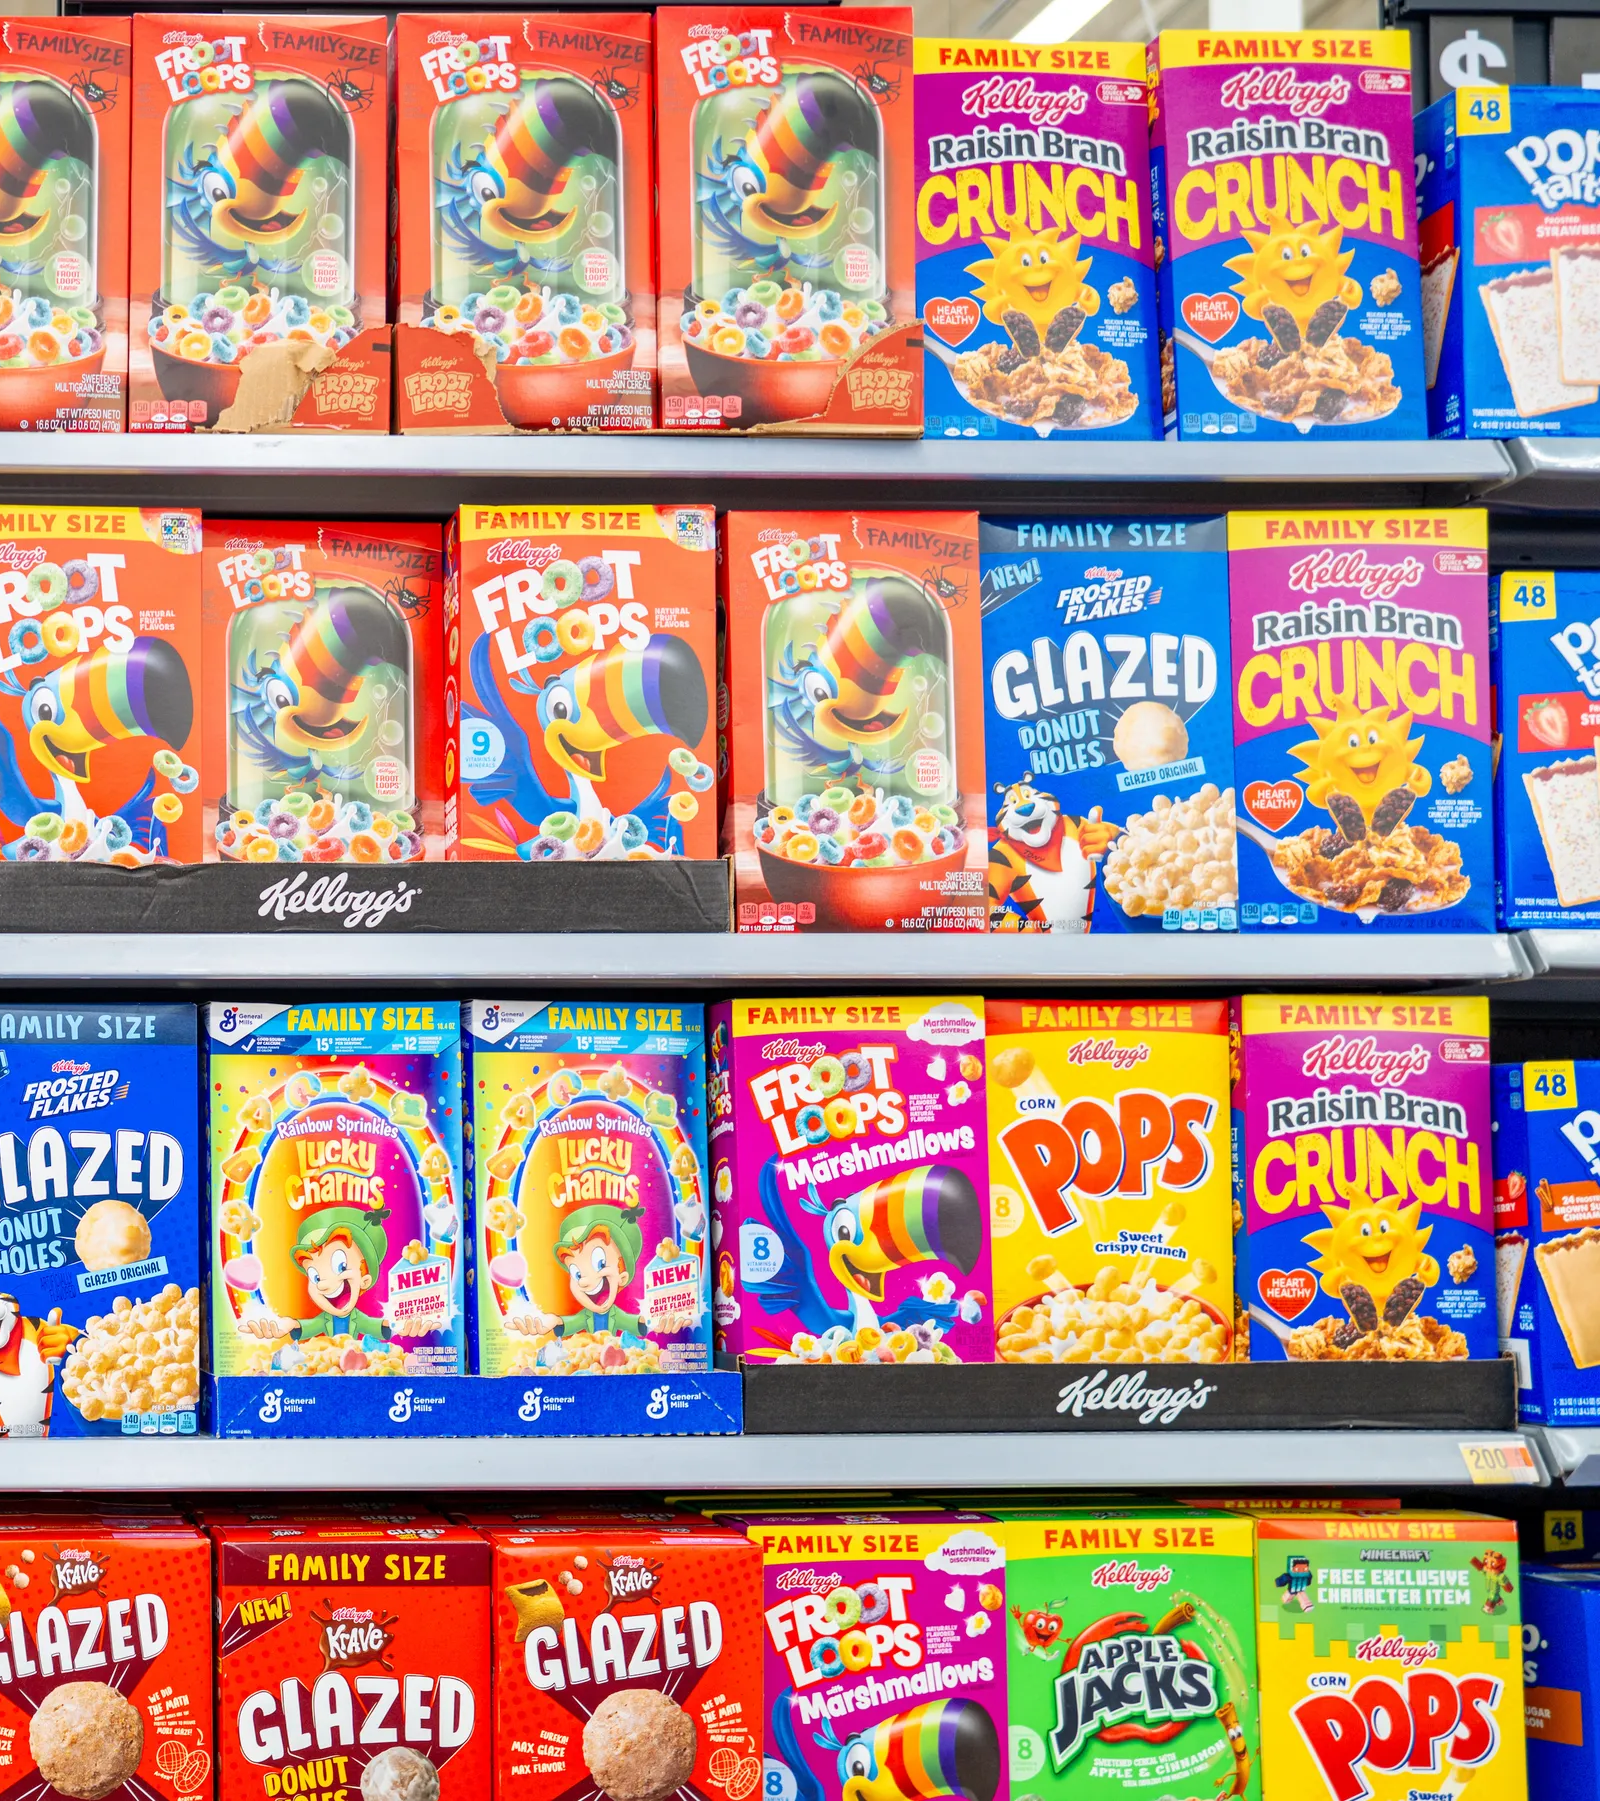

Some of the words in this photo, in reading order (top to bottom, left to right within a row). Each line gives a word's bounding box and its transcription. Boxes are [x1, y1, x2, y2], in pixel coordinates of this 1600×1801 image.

[420, 36, 511, 79] FROOT
[939, 48, 1042, 69] FAMILY
[1050, 50, 1111, 69] SIZE
[1197, 40, 1302, 59] FAMILY
[1311, 39, 1372, 58] SIZE
[1439, 30, 1508, 86] $
[431, 66, 517, 101] LOOPS
[1220, 66, 1352, 117] Kellogg's
[961, 77, 1089, 125] Kellogg's
[1469, 101, 1501, 122] 48
[933, 130, 1043, 171] Raisin
[1049, 135, 1123, 171] Bran
[1191, 122, 1304, 164] Raisin
[1309, 128, 1387, 164] Bran
[916, 163, 1141, 249] CRUNCH
[1175, 155, 1403, 241] CRUNCH
[931, 314, 975, 325] HEALTHY
[937, 304, 969, 316] HEART
[67, 515, 126, 533] SIZE
[1017, 525, 1112, 546] FAMILY
[1128, 525, 1187, 545] SIZE
[1266, 521, 1365, 539] FAMILY
[1376, 520, 1448, 538] SIZE
[487, 541, 560, 564] Kellogg's
[752, 535, 840, 579] FROOT
[763, 564, 847, 599] LOOPS
[991, 560, 1041, 591] NEW!
[1289, 549, 1424, 598] Kellogg's
[472, 550, 641, 632] FROOT
[1057, 575, 1152, 610] FROSTED
[1513, 586, 1546, 608] 48
[1063, 598, 1147, 624] FLAKES
[1256, 605, 1369, 646] Raisin
[1374, 609, 1460, 646] Bran
[497, 603, 650, 673] LOOPS
[992, 632, 1217, 721] GLAZED
[1238, 640, 1476, 727] CRUNCH
[1019, 710, 1100, 751] DONUT
[1032, 741, 1104, 775] HOLES
[1123, 771, 1157, 787] GLAZED
[1159, 762, 1198, 780] ORIGINAL
[259, 871, 422, 928] Kellogg's
[98, 1015, 156, 1039] SIZE
[287, 1008, 374, 1033] FAMILY
[381, 1007, 435, 1031] SIZE
[748, 1006, 836, 1024] FAMILY
[847, 1006, 901, 1023] SIZE
[923, 1017, 977, 1028] Marshmallow
[1022, 1007, 1127, 1028] FAMILY
[1136, 1008, 1192, 1028] SIZE
[1280, 1006, 1381, 1026] FAMILY
[1392, 1006, 1453, 1026] SIZE
[761, 1040, 825, 1061] Kellogg's
[1068, 1039, 1151, 1069] Kellogg's
[1303, 1035, 1430, 1085] Kellogg's
[24, 1071, 119, 1105] FROSTED
[751, 1046, 894, 1120] FROOT
[1534, 1075, 1568, 1097] 48
[30, 1092, 114, 1119] FLAKES
[1020, 1098, 1055, 1111] CORN
[1272, 1094, 1379, 1133] Raisin
[1384, 1098, 1465, 1134] Bran
[277, 1117, 334, 1139] Rainbow
[336, 1115, 399, 1139] Sprinkles
[772, 1091, 904, 1154] LOOPS
[297, 1139, 376, 1178] Lucky
[557, 1138, 633, 1174] Lucky
[787, 1125, 976, 1192] Marshmallows
[1003, 1095, 1212, 1235] POPS
[1253, 1127, 1481, 1214] CRUNCH
[286, 1175, 385, 1212] Charms
[547, 1172, 640, 1209] Charms
[753, 1236, 770, 1260] 8
[1095, 1242, 1138, 1256] Crispy
[1140, 1244, 1186, 1259] Crunch
[1118, 1232, 1163, 1244] Sweet
[84, 1272, 118, 1289] GLAZED
[121, 1260, 161, 1281] ORIGINAL
[398, 1266, 440, 1292] NEW
[394, 1307, 415, 1318] CAKE
[416, 1301, 446, 1314] FLAVOR
[398, 1294, 441, 1309] BIRTHDAY
[284, 1397, 316, 1406] General
[284, 1404, 303, 1413] Mills
[542, 1396, 575, 1405] General
[542, 1403, 562, 1412] Mills
[1056, 1370, 1218, 1424] Kellogg's
[1044, 1528, 1142, 1549] FAMILY
[1157, 1528, 1214, 1547] SIZE
[1324, 1523, 1401, 1539] FAMILY
[1408, 1523, 1457, 1539] SIZE
[268, 1554, 370, 1581] FAMILY
[386, 1554, 446, 1580] SIZE
[1359, 1549, 1433, 1562] MINECRAFT
[776, 1570, 842, 1592] Kellogg's
[1091, 1561, 1172, 1591] Kellogg's
[1317, 1570, 1363, 1587] FREE
[1370, 1570, 1469, 1586] EXCLUSIVE
[239, 1591, 292, 1628] NEW!
[1317, 1588, 1418, 1605] CHARACTER
[1425, 1589, 1471, 1605] ITEM
[765, 1576, 912, 1651] FROOT
[524, 1601, 723, 1691] GLAZED
[785, 1624, 921, 1689] LOOPS
[1080, 1639, 1180, 1675] APPLE
[1356, 1635, 1439, 1664] Kellogg's
[799, 1657, 995, 1725] Marshmallows
[1311, 1676, 1346, 1688] CORN
[239, 1674, 475, 1765] GLAZED
[1052, 1663, 1213, 1759] JACKS
[1294, 1672, 1496, 1799] POPS
[264, 1755, 349, 1797] DONUT
